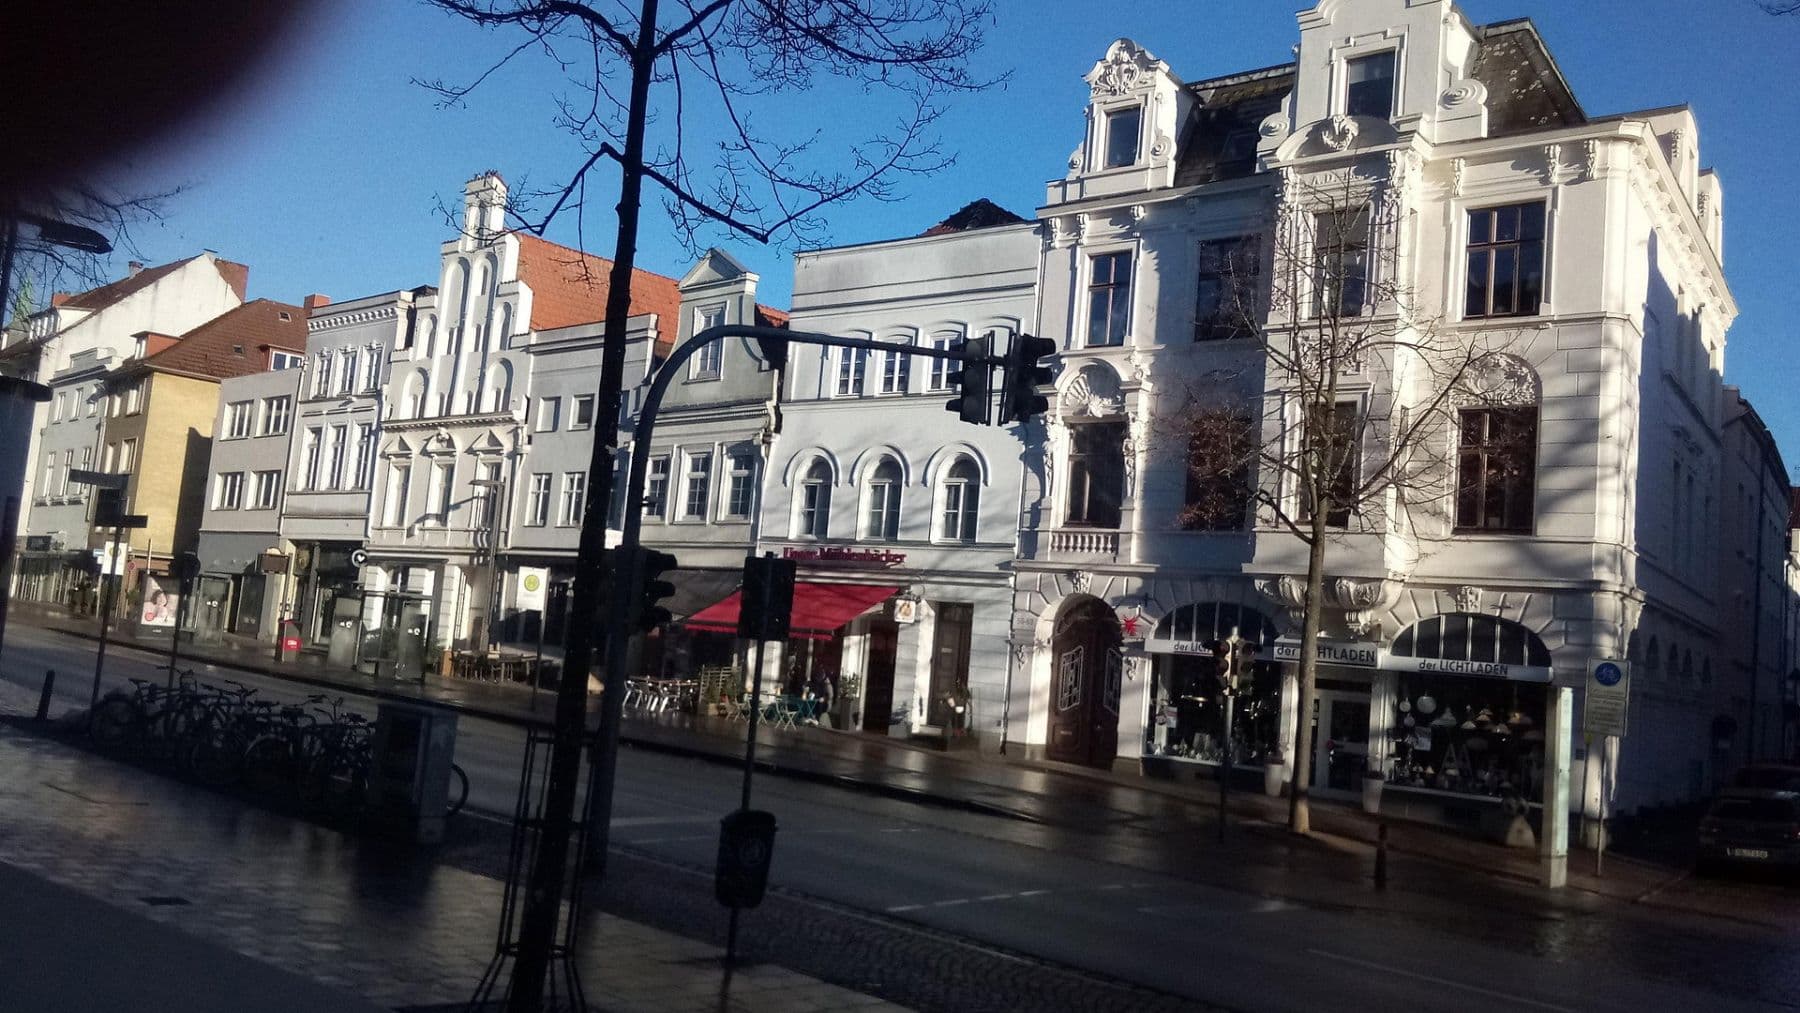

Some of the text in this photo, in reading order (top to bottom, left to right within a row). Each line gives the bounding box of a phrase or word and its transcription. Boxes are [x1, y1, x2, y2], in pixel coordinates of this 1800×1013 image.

[1174, 641, 1188, 651] der
[1277, 645, 1297, 657] der
[1419, 659, 1508, 676] der LICHTLADEN
